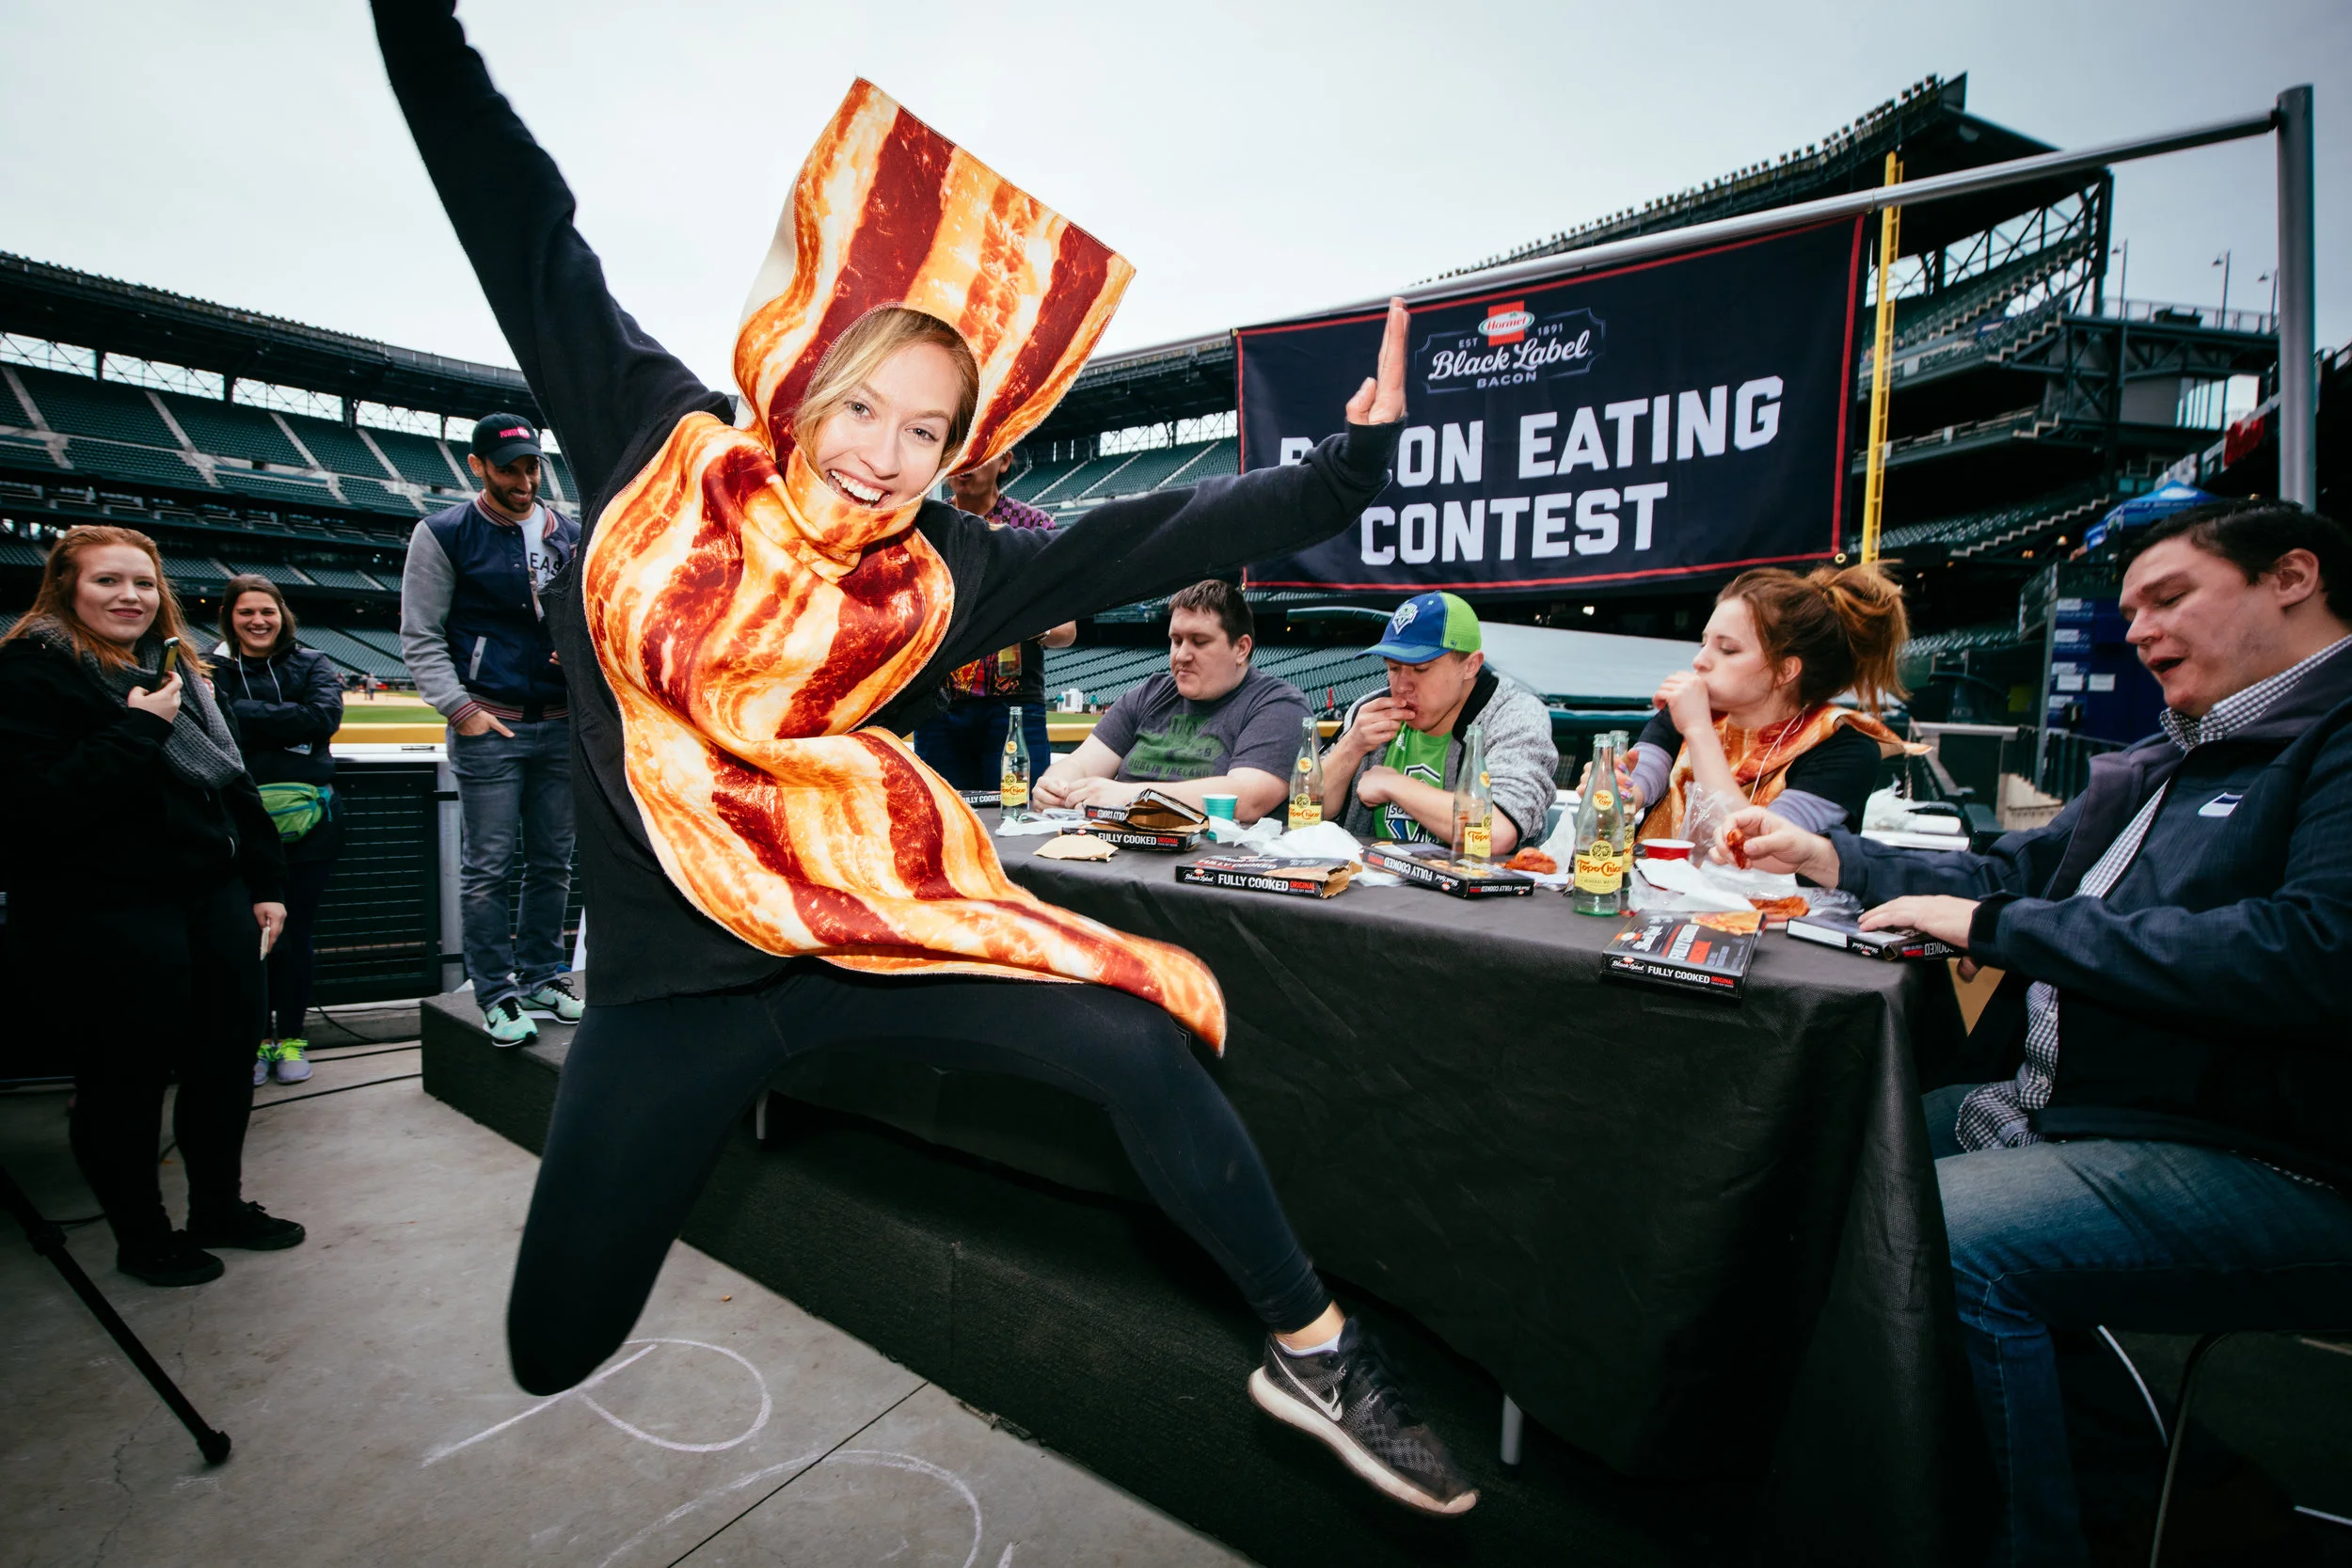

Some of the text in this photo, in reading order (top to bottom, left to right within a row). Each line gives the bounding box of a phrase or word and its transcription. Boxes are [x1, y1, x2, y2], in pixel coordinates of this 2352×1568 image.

[1458, 323, 1564, 349] EST 1891
[1427, 329, 1591, 381] Black Label
[1476, 371, 1538, 389] BACON
[1518, 375, 1784, 480] EATING
[1360, 481, 1668, 565] CONTEST
[1098, 832, 1122, 844] FULLY
[1123, 834, 1157, 846] COOKED
[1217, 873, 1248, 887] FULLY
[1248, 876, 1289, 892] COOKED
[1647, 965, 1673, 977] FULLY
[1674, 970, 1710, 984] COOKED
